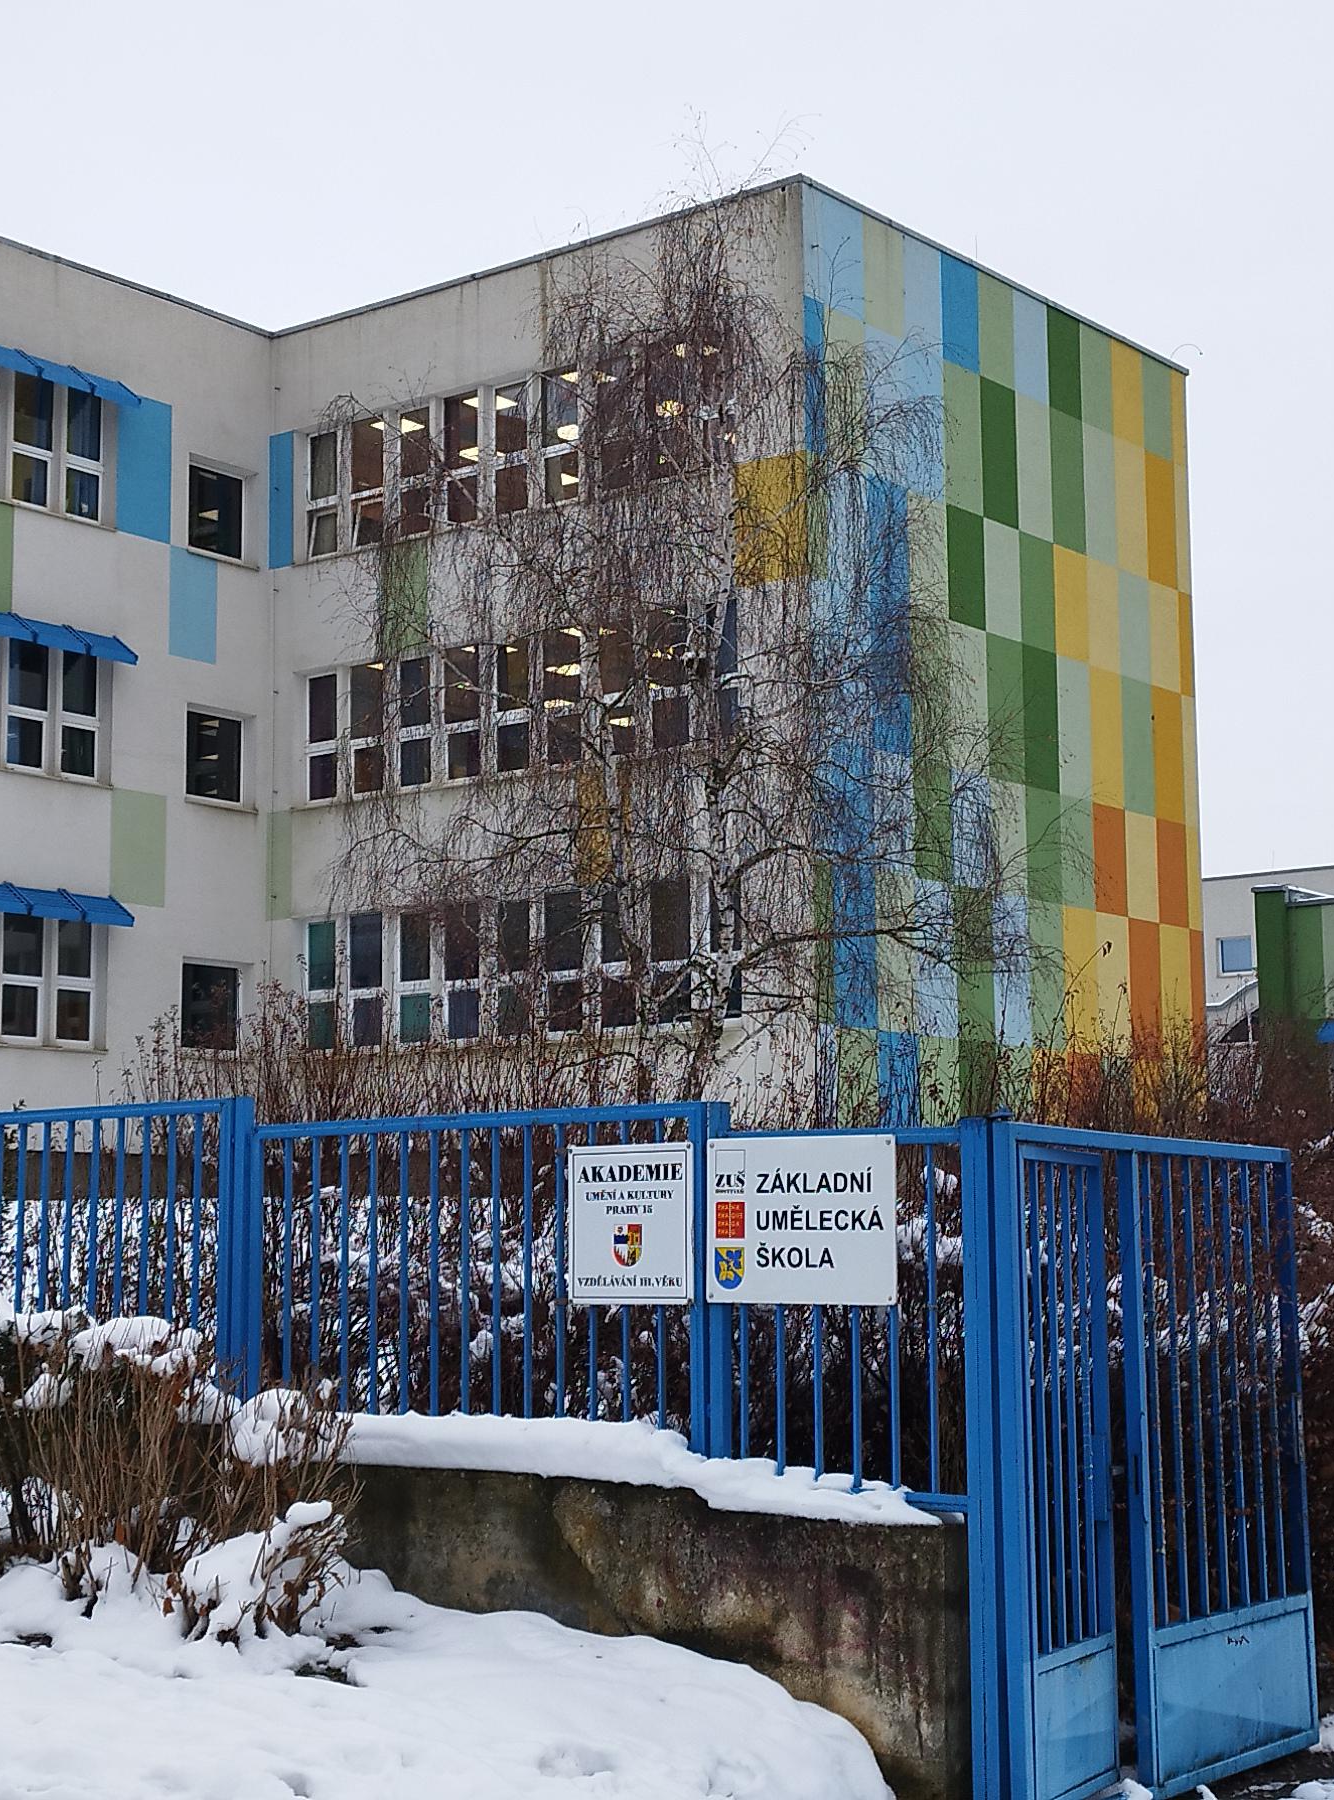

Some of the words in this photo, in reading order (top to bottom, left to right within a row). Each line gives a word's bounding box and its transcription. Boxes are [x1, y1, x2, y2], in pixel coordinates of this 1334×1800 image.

[577, 1163, 683, 1183] AKADEMIE
[715, 1170, 746, 1188] ZUŠ
[756, 1166, 872, 1194] ZÁKLADNÍ
[585, 1189, 617, 1201] UMĚNÍ
[618, 1190, 625, 1200] A
[627, 1190, 674, 1200] KULTURY
[606, 1205, 639, 1214] PRAHY
[756, 1205, 884, 1231] UMĚLECKÁ
[756, 1242, 835, 1268] ŠKOLA
